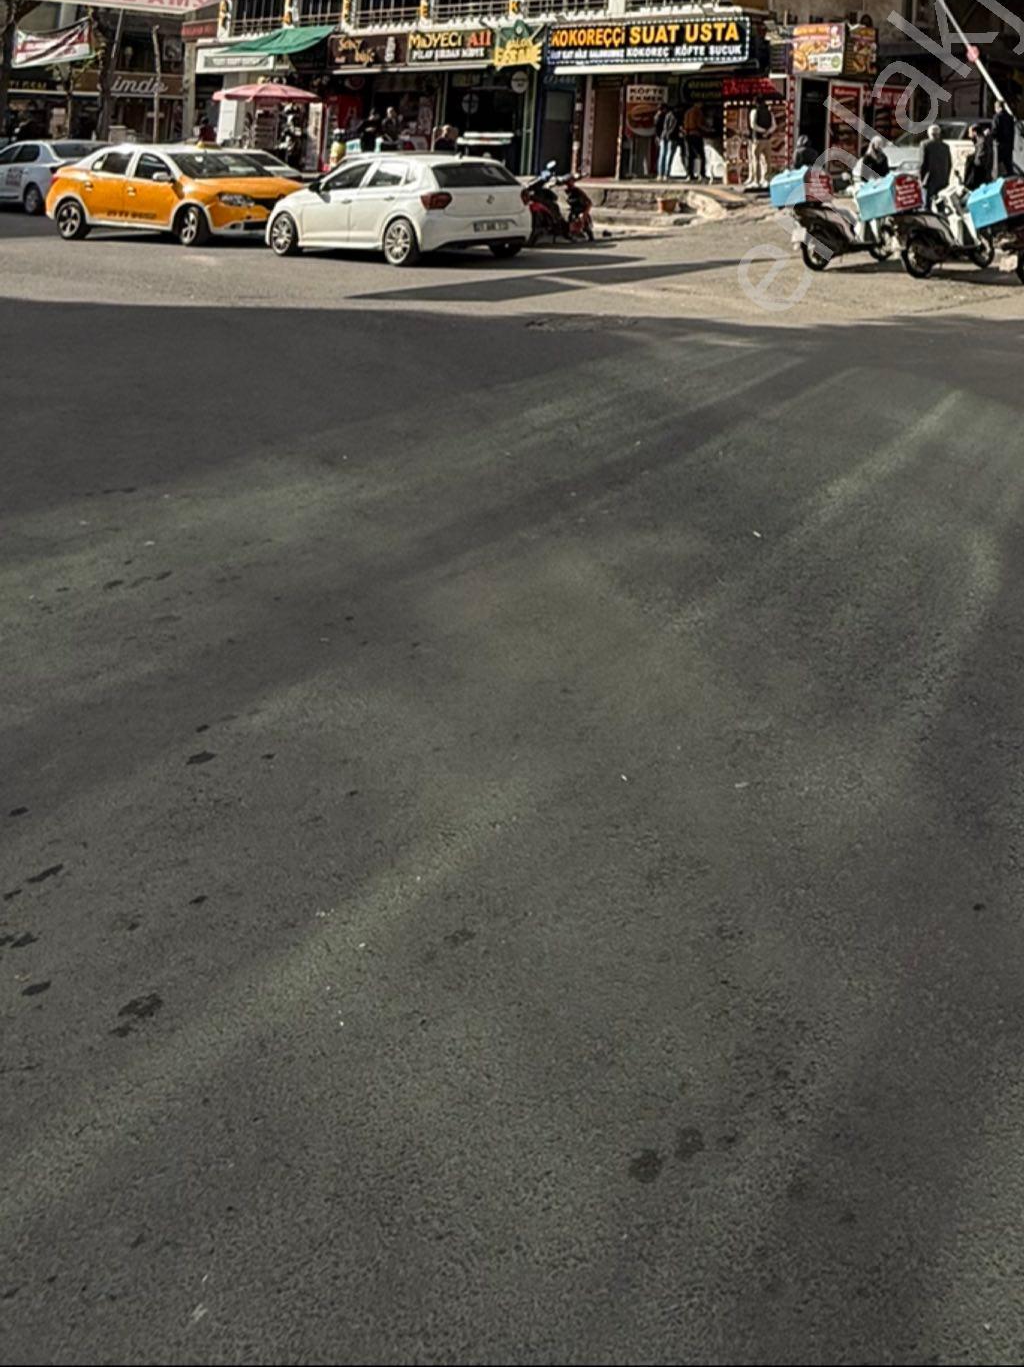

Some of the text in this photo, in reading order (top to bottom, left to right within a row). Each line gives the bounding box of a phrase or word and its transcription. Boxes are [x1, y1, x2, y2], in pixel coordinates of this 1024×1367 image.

[629, 24, 680, 44] SUAT
[685, 22, 739, 42] USTA
[709, 44, 742, 56] SUCUK
